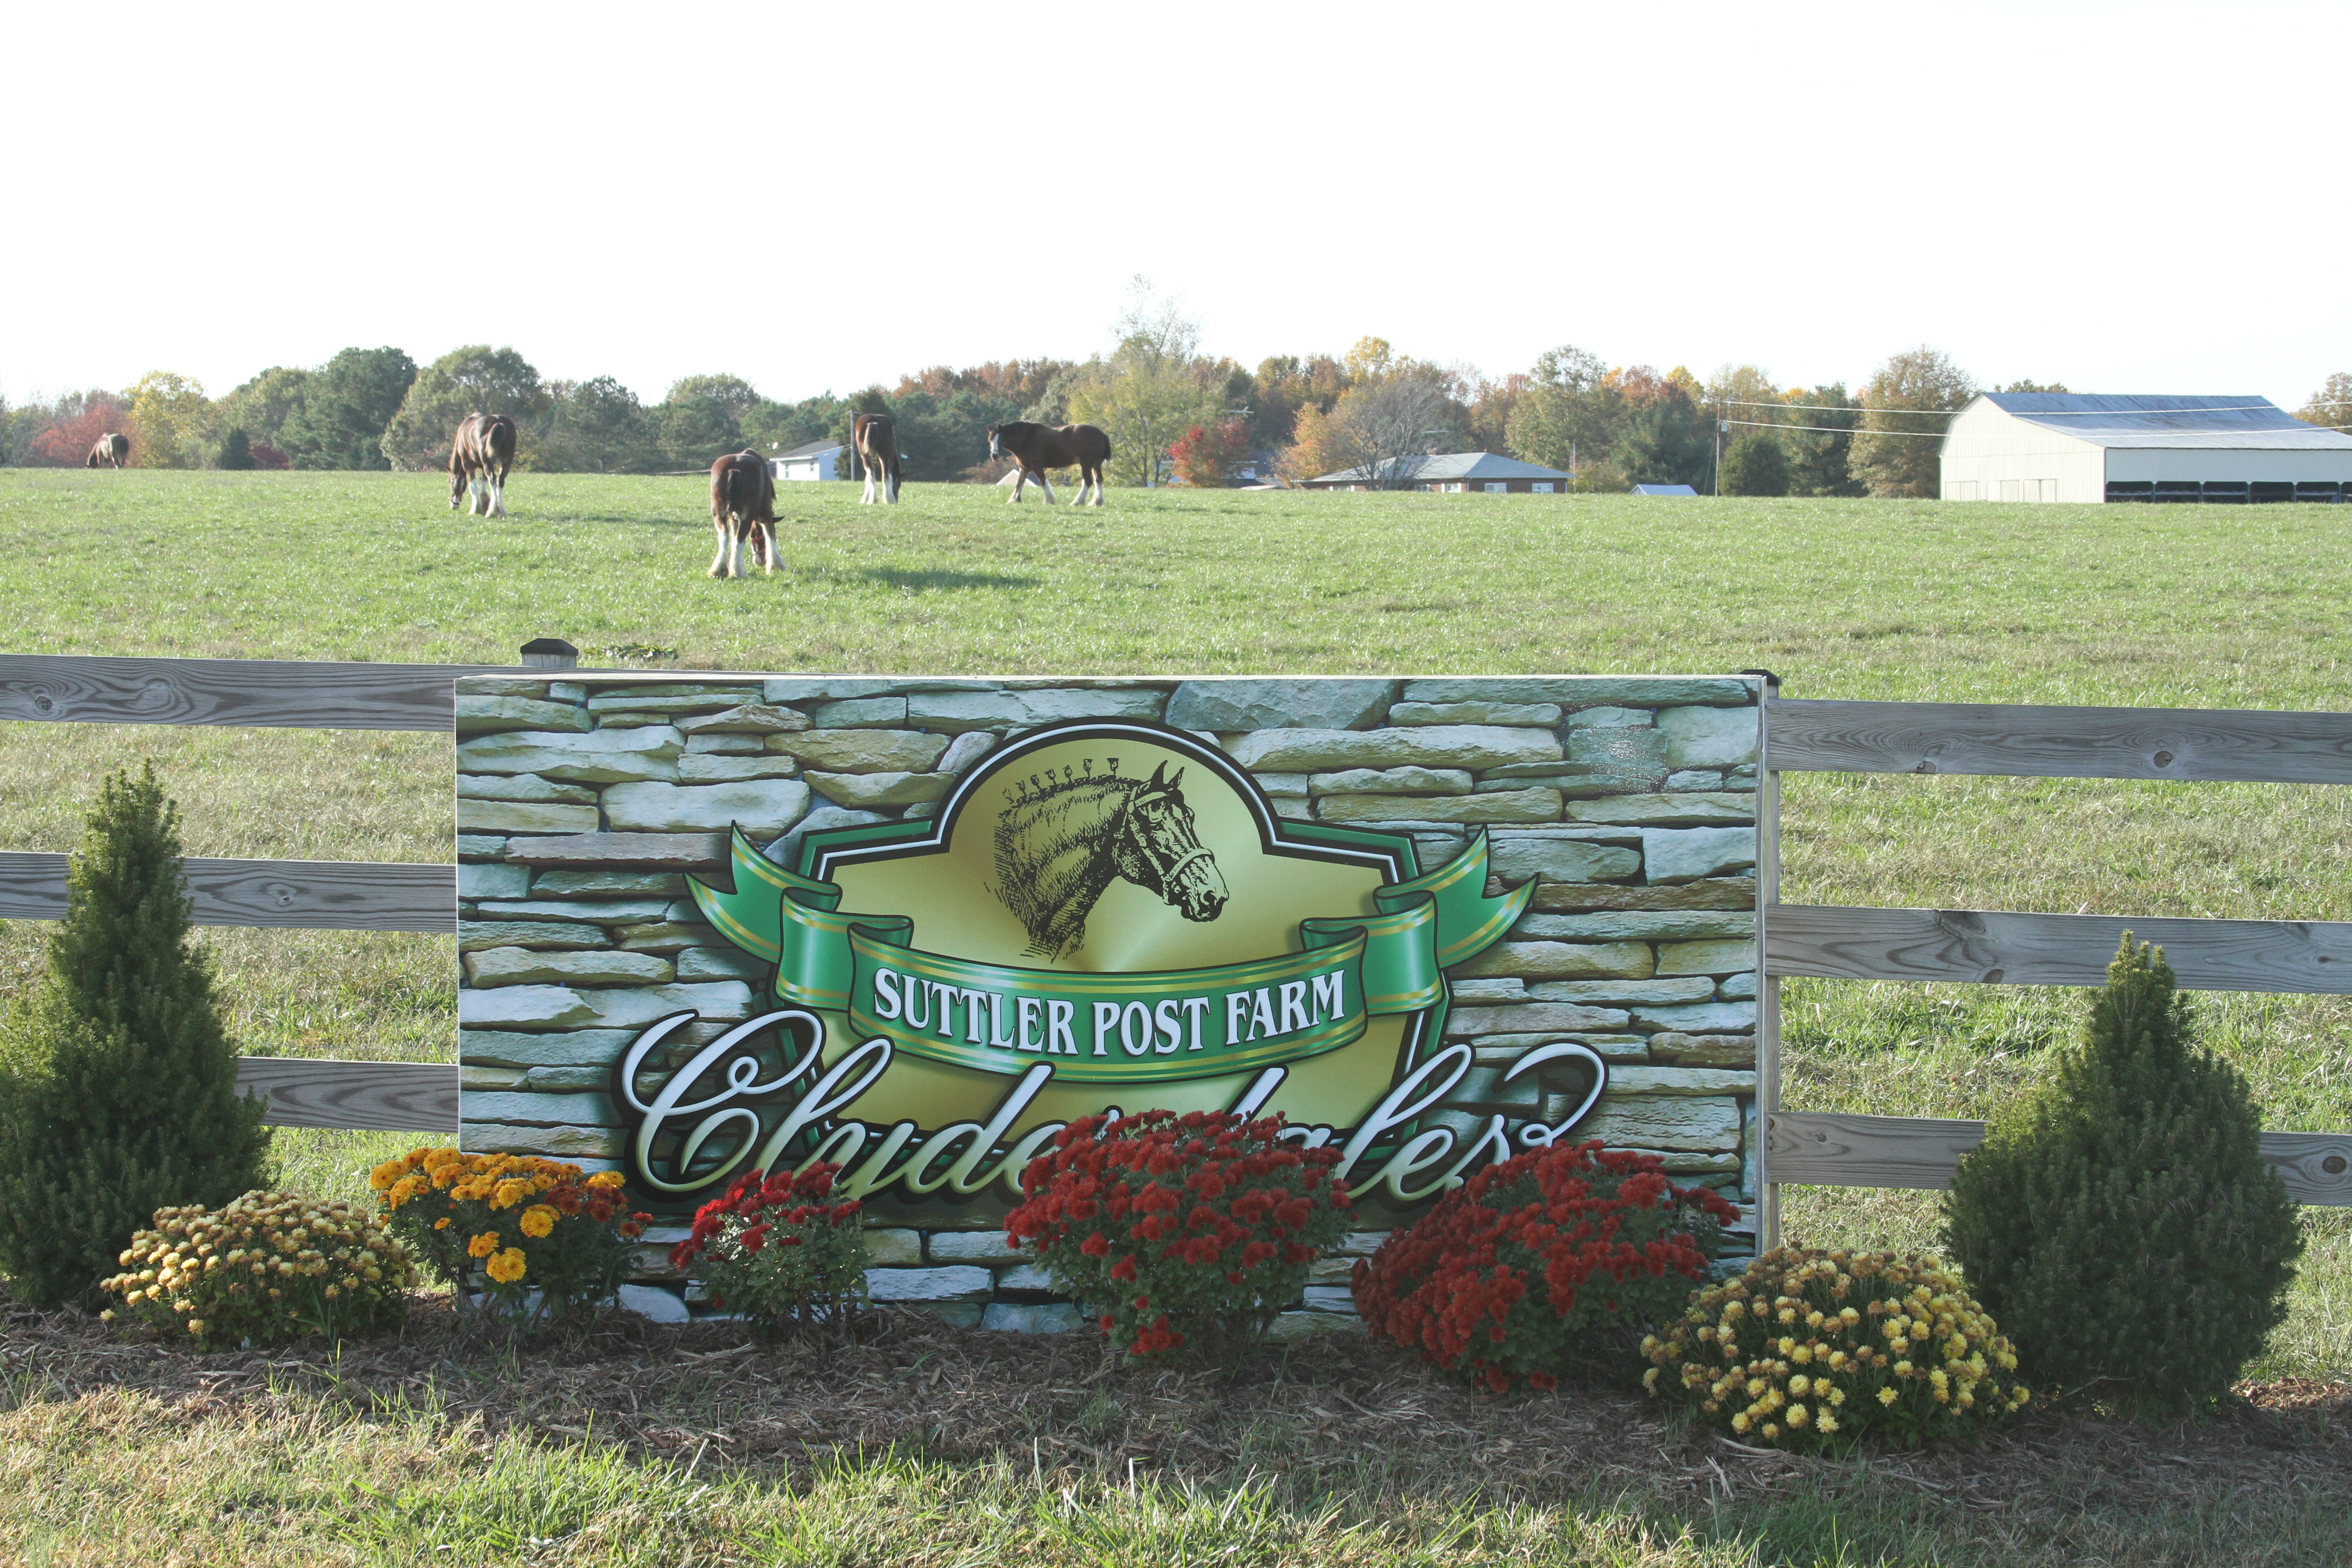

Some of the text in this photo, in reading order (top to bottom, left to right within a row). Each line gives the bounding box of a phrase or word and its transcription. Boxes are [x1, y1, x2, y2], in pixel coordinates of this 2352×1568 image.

[873, 966, 1346, 1057] SUTTLER POST FARM
